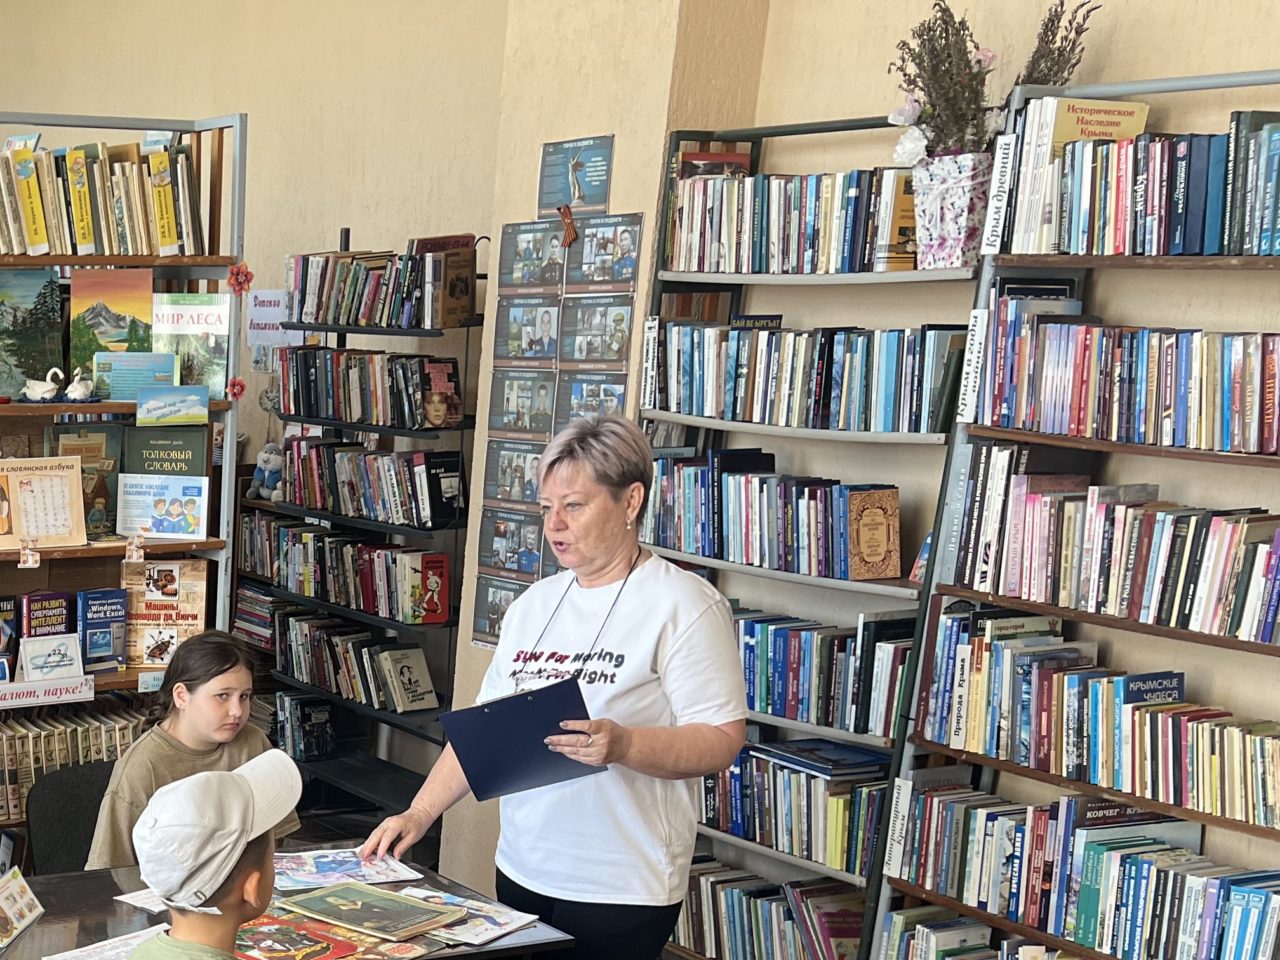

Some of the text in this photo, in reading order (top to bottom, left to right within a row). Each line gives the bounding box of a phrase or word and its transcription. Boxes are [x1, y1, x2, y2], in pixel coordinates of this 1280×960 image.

[1067, 104, 1135, 117] Историческое
[1075, 116, 1121, 128] Наследие
[1080, 127, 1113, 138] Крыма
[985, 142, 1011, 248] Крым древний
[1134, 173, 1147, 210] Крым
[155, 313, 223, 326] МИР ЛЕСА
[957, 371, 971, 418] Крым
[967, 315, 979, 355] годы
[971, 342, 982, 393] войны
[142, 449, 192, 459] ТОЛКОВЫЙ
[6, 464, 48, 473] славянская
[49, 463, 74, 471] азбука
[144, 461, 188, 471] СЛОВАРЬ
[31, 599, 67, 611] КАК РАЗВИТЬ
[91, 604, 123, 612] Windows,
[145, 602, 179, 611] Машины
[31, 607, 67, 619] СУПЕРПАМЯТЬ
[106, 609, 125, 617] Excel
[163, 613, 173, 621] да
[176, 612, 198, 621] Винчи
[31, 616, 66, 627] ИНТЕЛЛЕКТ
[36, 624, 66, 635] ВНИМАНИЕ
[513, 650, 544, 663] SUN
[545, 652, 571, 664] For
[1129, 678, 1179, 691] КРЫМСКИЕ
[43, 682, 85, 700] науке!
[954, 657, 966, 736] Природа Крыма
[1143, 690, 1179, 701] ЧУДЕСА
[1086, 808, 1120, 818] КОВЧЕГ
[885, 784, 902, 871] Литературный
[896, 814, 906, 845] Крым
[1127, 879, 1135, 919] ПРИКЛЮЧЕНИЕ
[1137, 879, 1147, 926] ПРИКЛЮЧЕНИЕ
